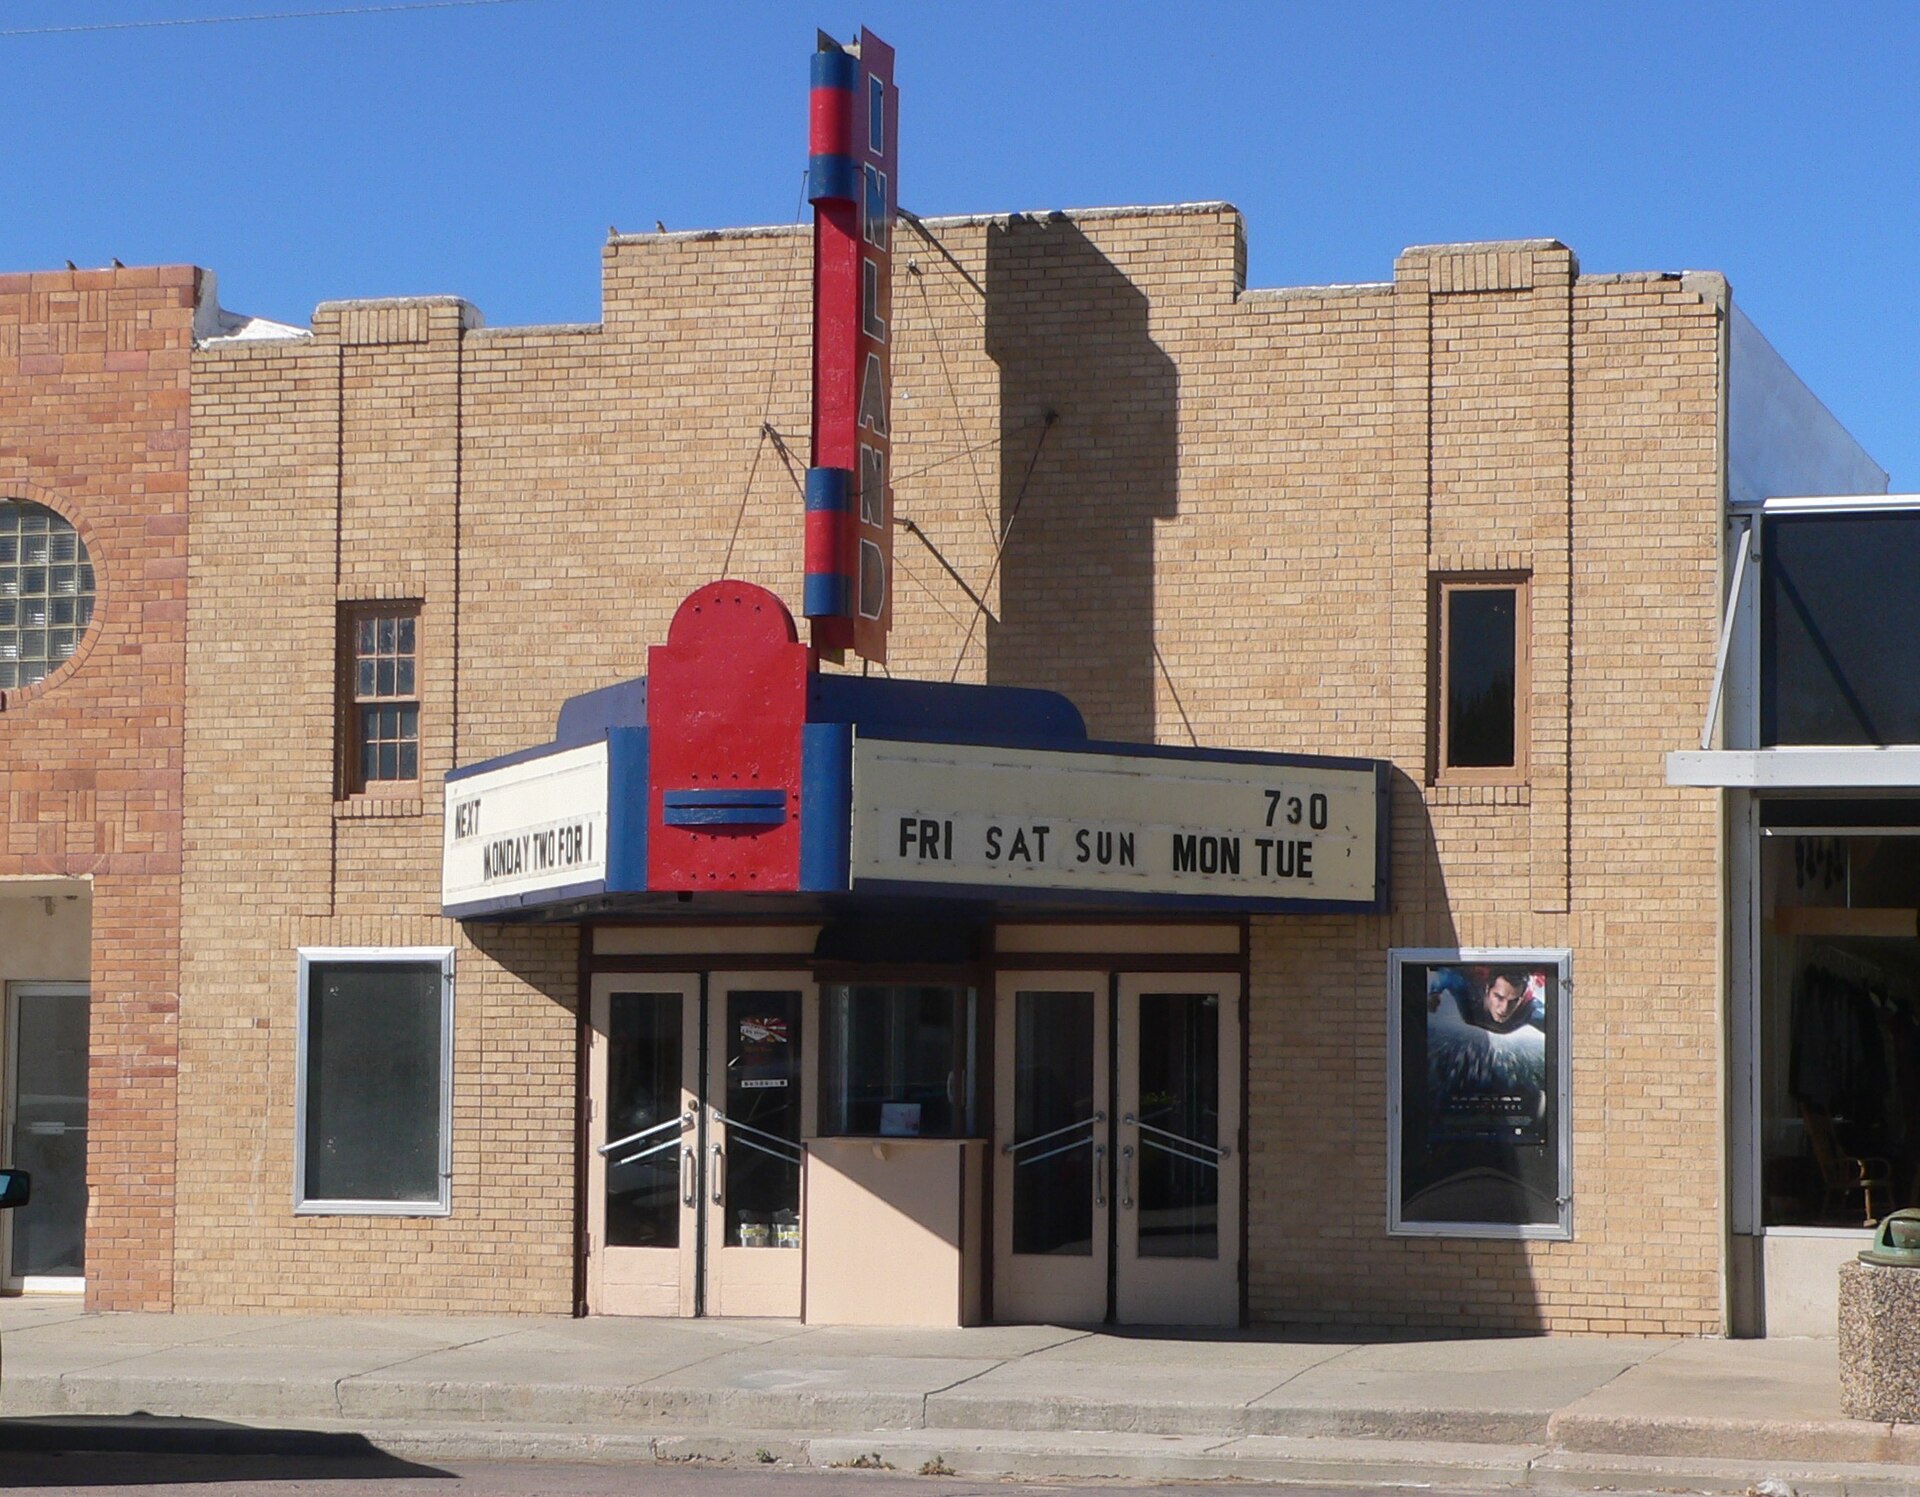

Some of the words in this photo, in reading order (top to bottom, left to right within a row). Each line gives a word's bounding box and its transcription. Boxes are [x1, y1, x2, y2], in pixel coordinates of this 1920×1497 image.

[858, 72, 887, 620] INLAND
[455, 799, 481, 839] NEXT
[1264, 789, 1329, 831] 730
[484, 835, 530, 881] MONDAY
[533, 830, 555, 870] TWO
[558, 825, 582, 866] FOR
[899, 817, 953, 861] FRI
[985, 825, 1051, 863] SAT
[1076, 828, 1135, 868] SUN
[1172, 833, 1241, 876] MON
[1254, 838, 1313, 879] TUE
